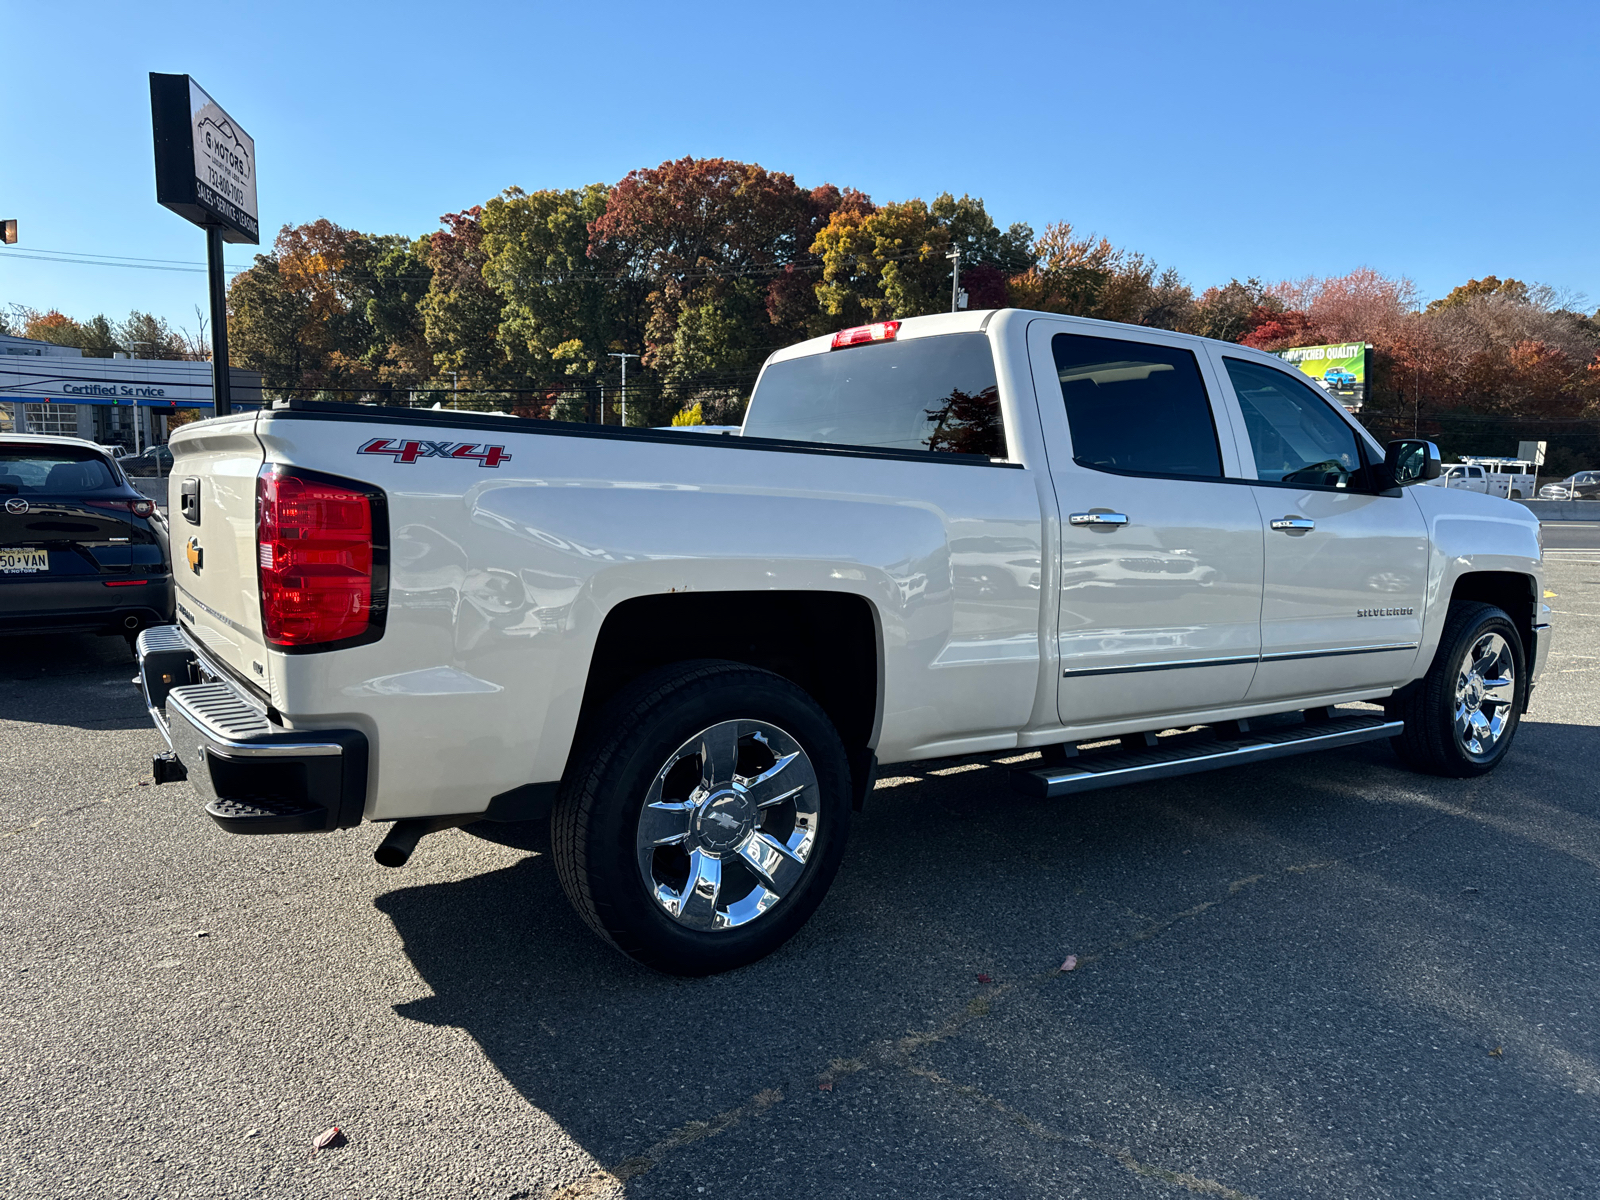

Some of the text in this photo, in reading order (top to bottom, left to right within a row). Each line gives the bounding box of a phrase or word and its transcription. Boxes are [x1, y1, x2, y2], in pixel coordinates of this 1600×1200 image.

[196, 181, 258, 235] SALES SERVICE LEASING
[1326, 345, 1359, 359] QUALITY
[63, 384, 165, 396] Certified Service
[1357, 606, 1414, 618] SILVERADO
